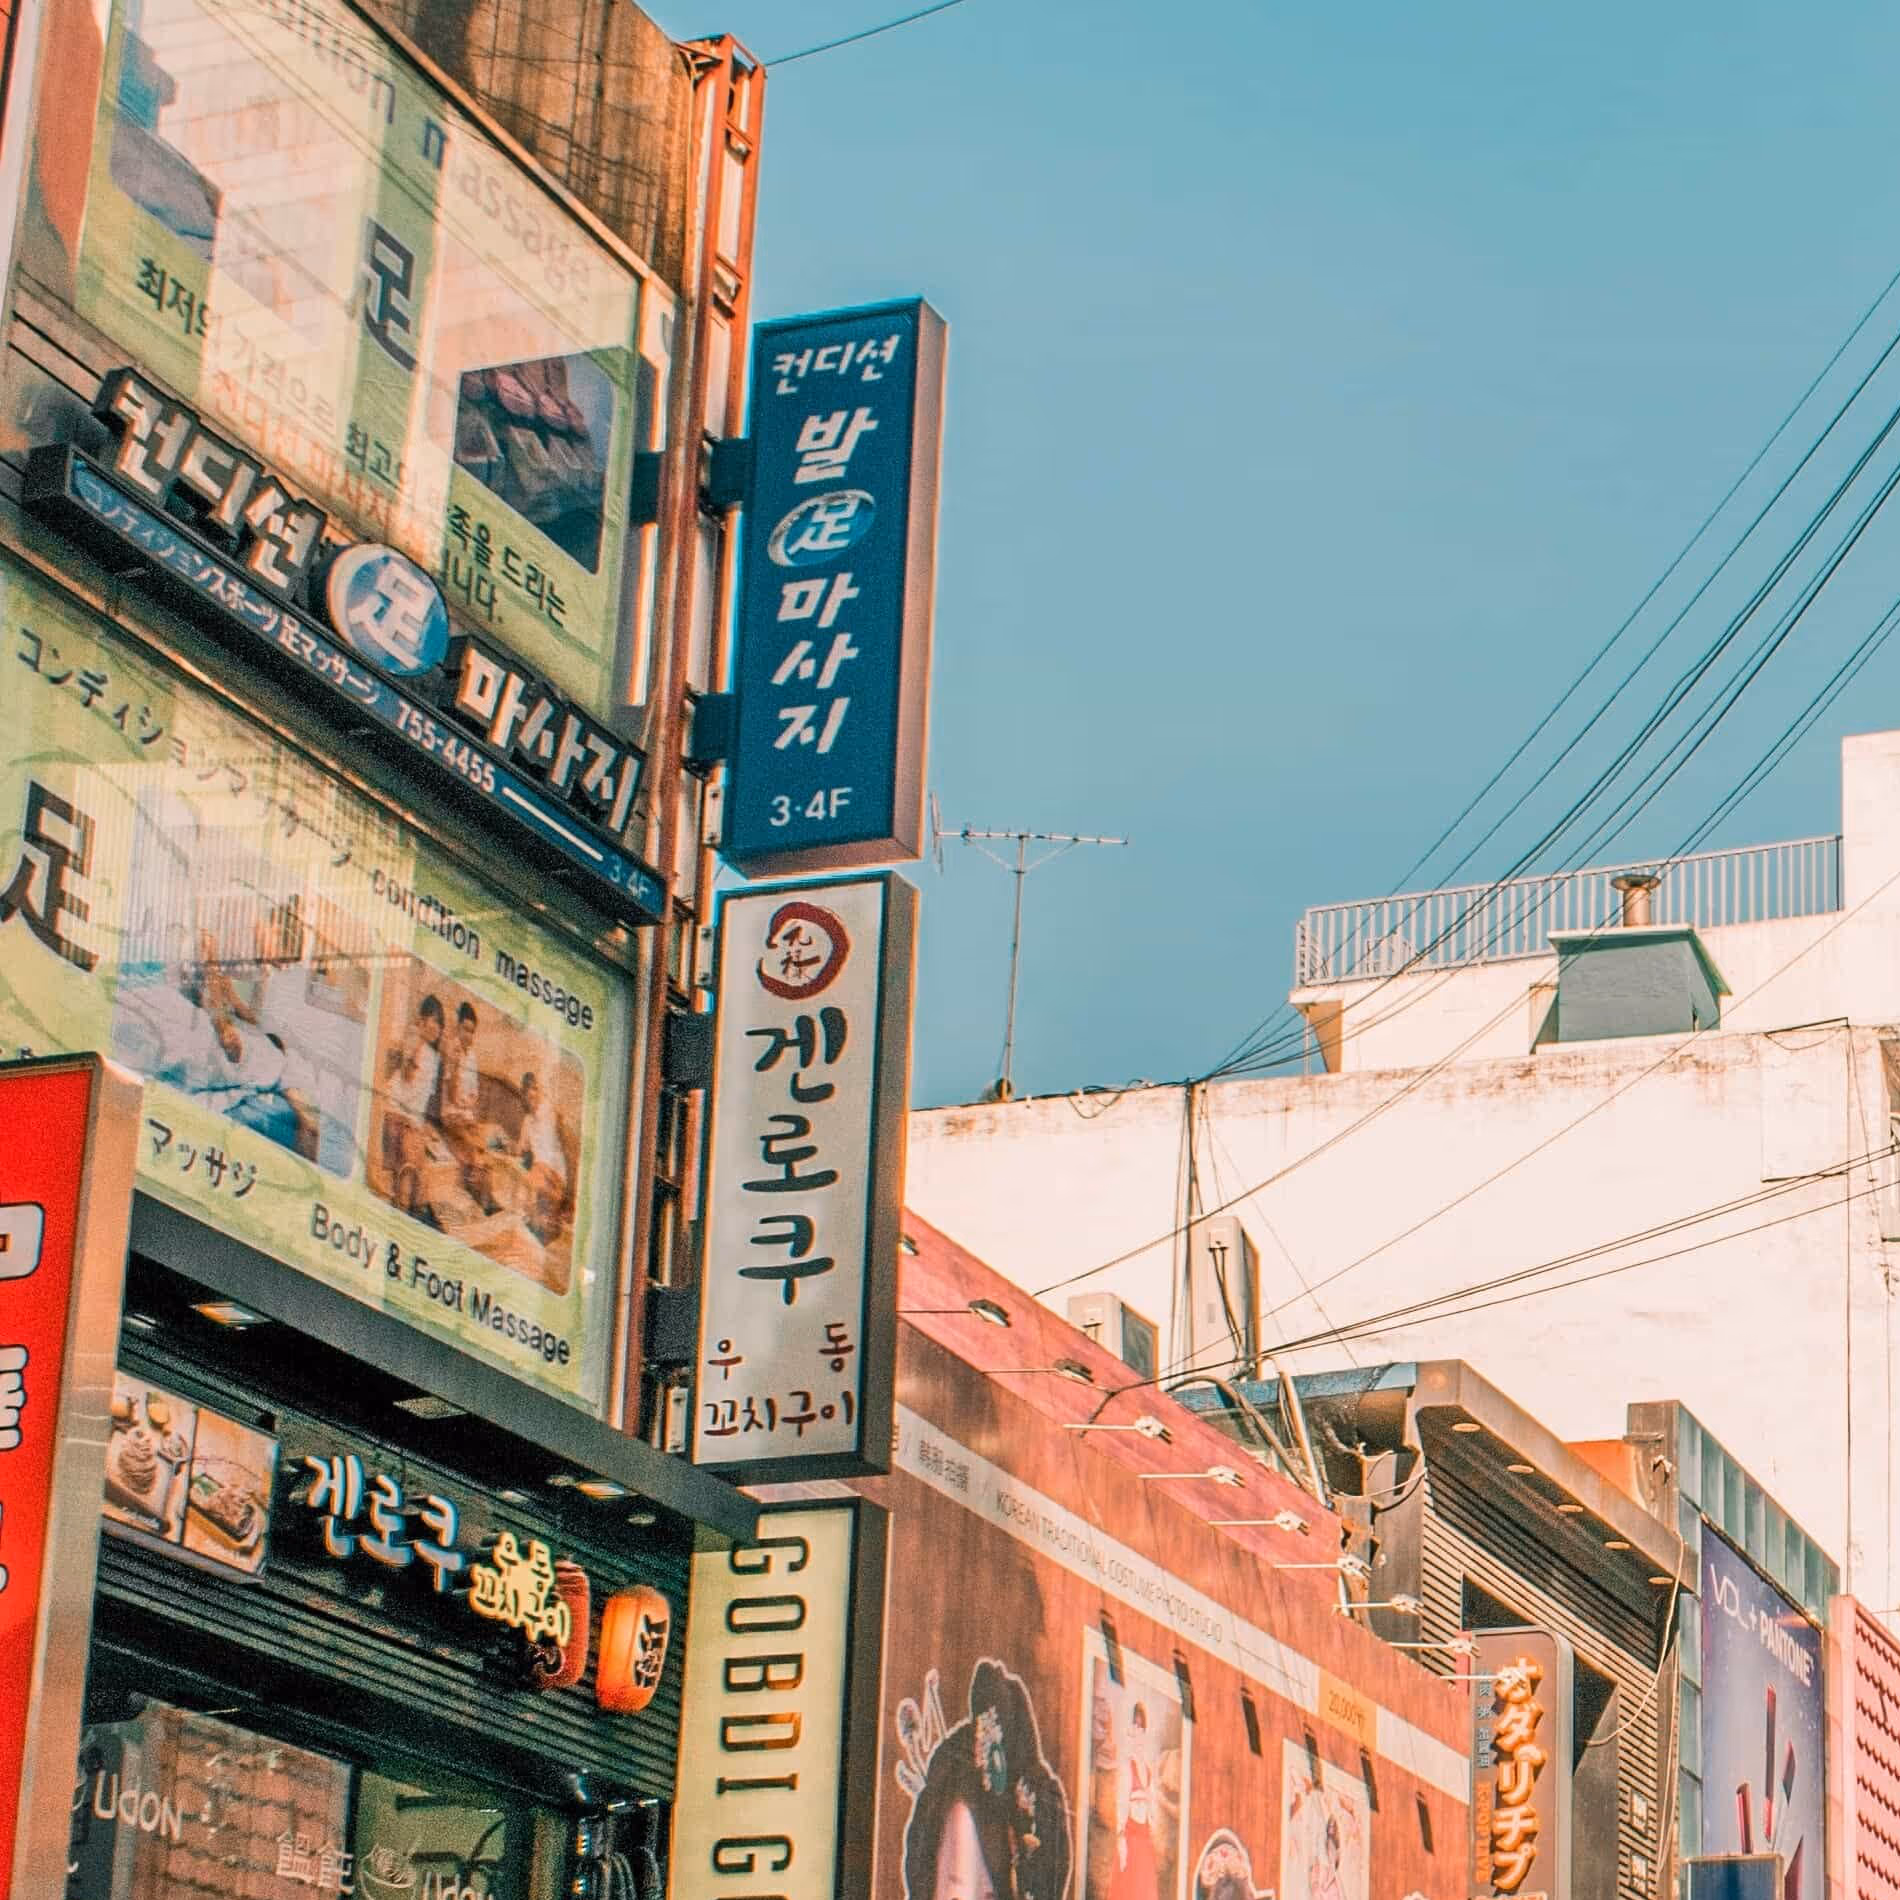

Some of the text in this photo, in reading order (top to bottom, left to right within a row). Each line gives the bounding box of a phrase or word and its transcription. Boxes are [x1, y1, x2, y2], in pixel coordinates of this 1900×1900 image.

[771, 333, 901, 395] 컨디션
[110, 378, 645, 832] 컨디션 足 마사지
[501, 546, 566, 629] 드리는
[398, 703, 498, 793] 755-4455
[0, 780, 98, 974] 足
[495, 940, 595, 1032] massage
[739, 1006, 848, 1305] 겐로쿠
[310, 1203, 571, 1367] Body & Foot Massage
[704, 1390, 854, 1437] 꼬치구이
[305, 1455, 465, 1592] 겐로쿠
[997, 1488, 1041, 1537] KOREAN
[716, 1534, 810, 1795] GOBDI
